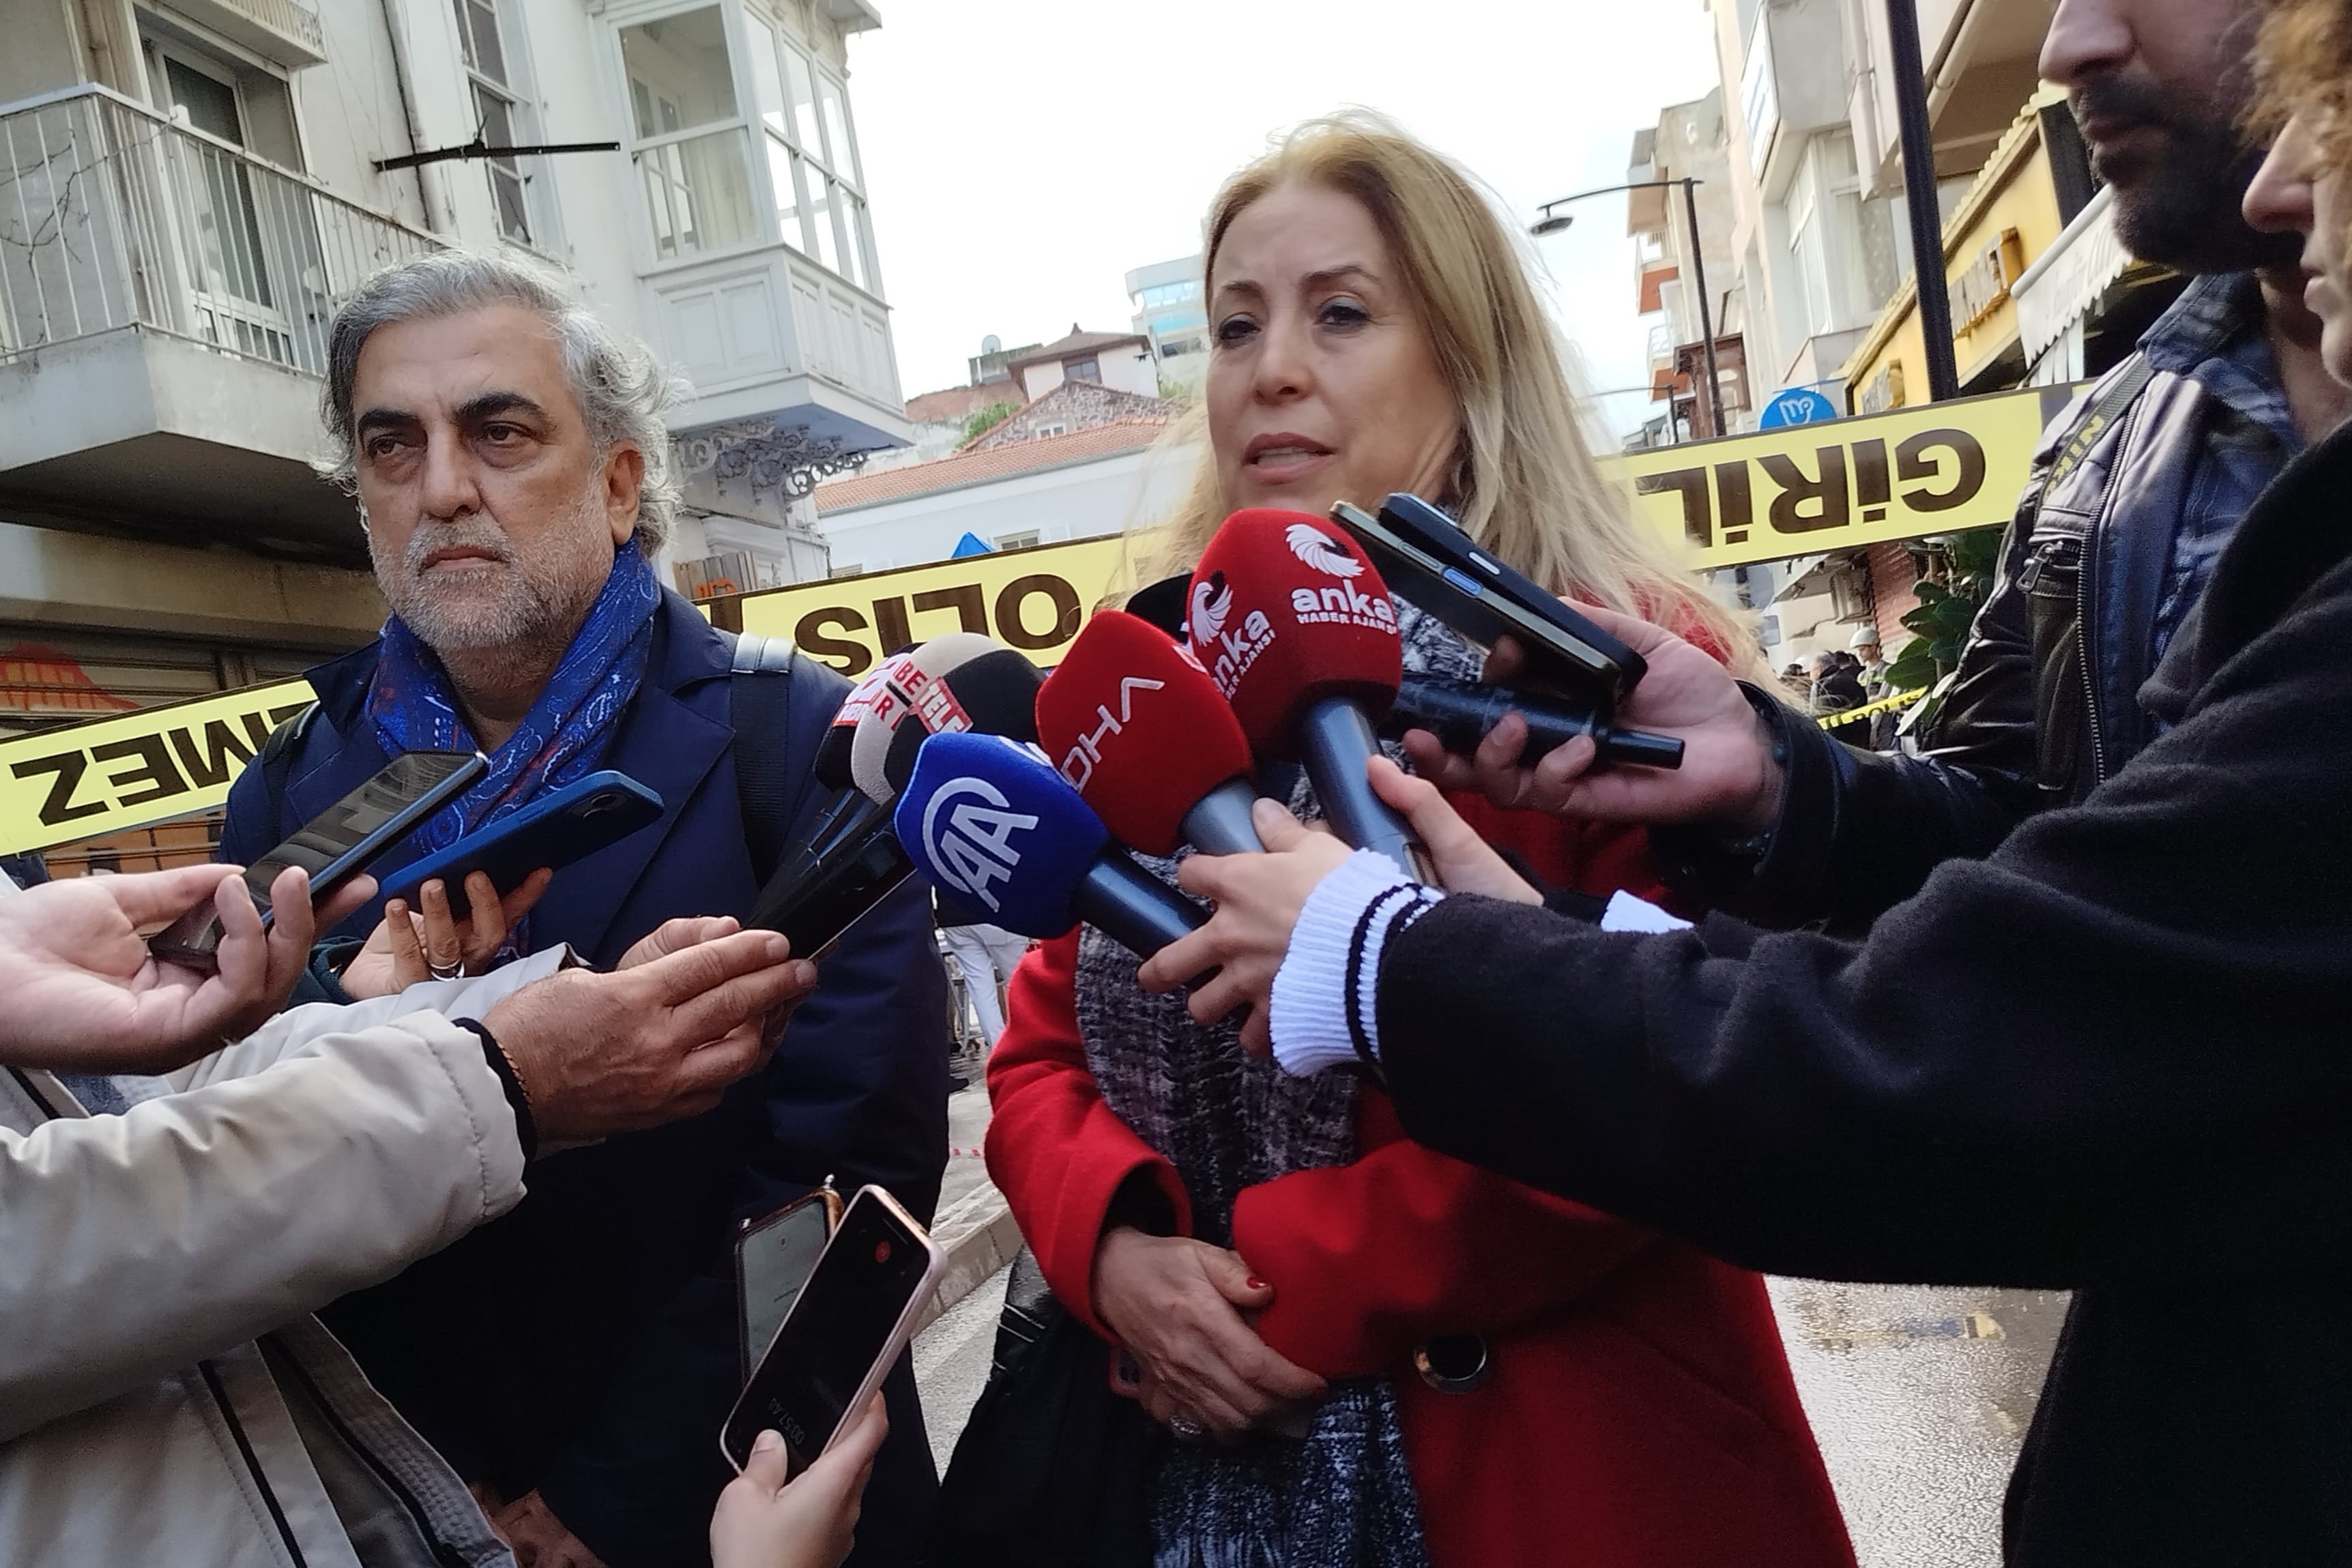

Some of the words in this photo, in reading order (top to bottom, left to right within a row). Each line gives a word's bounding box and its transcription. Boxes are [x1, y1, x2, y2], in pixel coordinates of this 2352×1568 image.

[1292, 579, 1395, 624] anka
[1296, 612, 1350, 624] HABER
[1060, 676, 1165, 795] DHA
[940, 803, 1039, 913] AA
